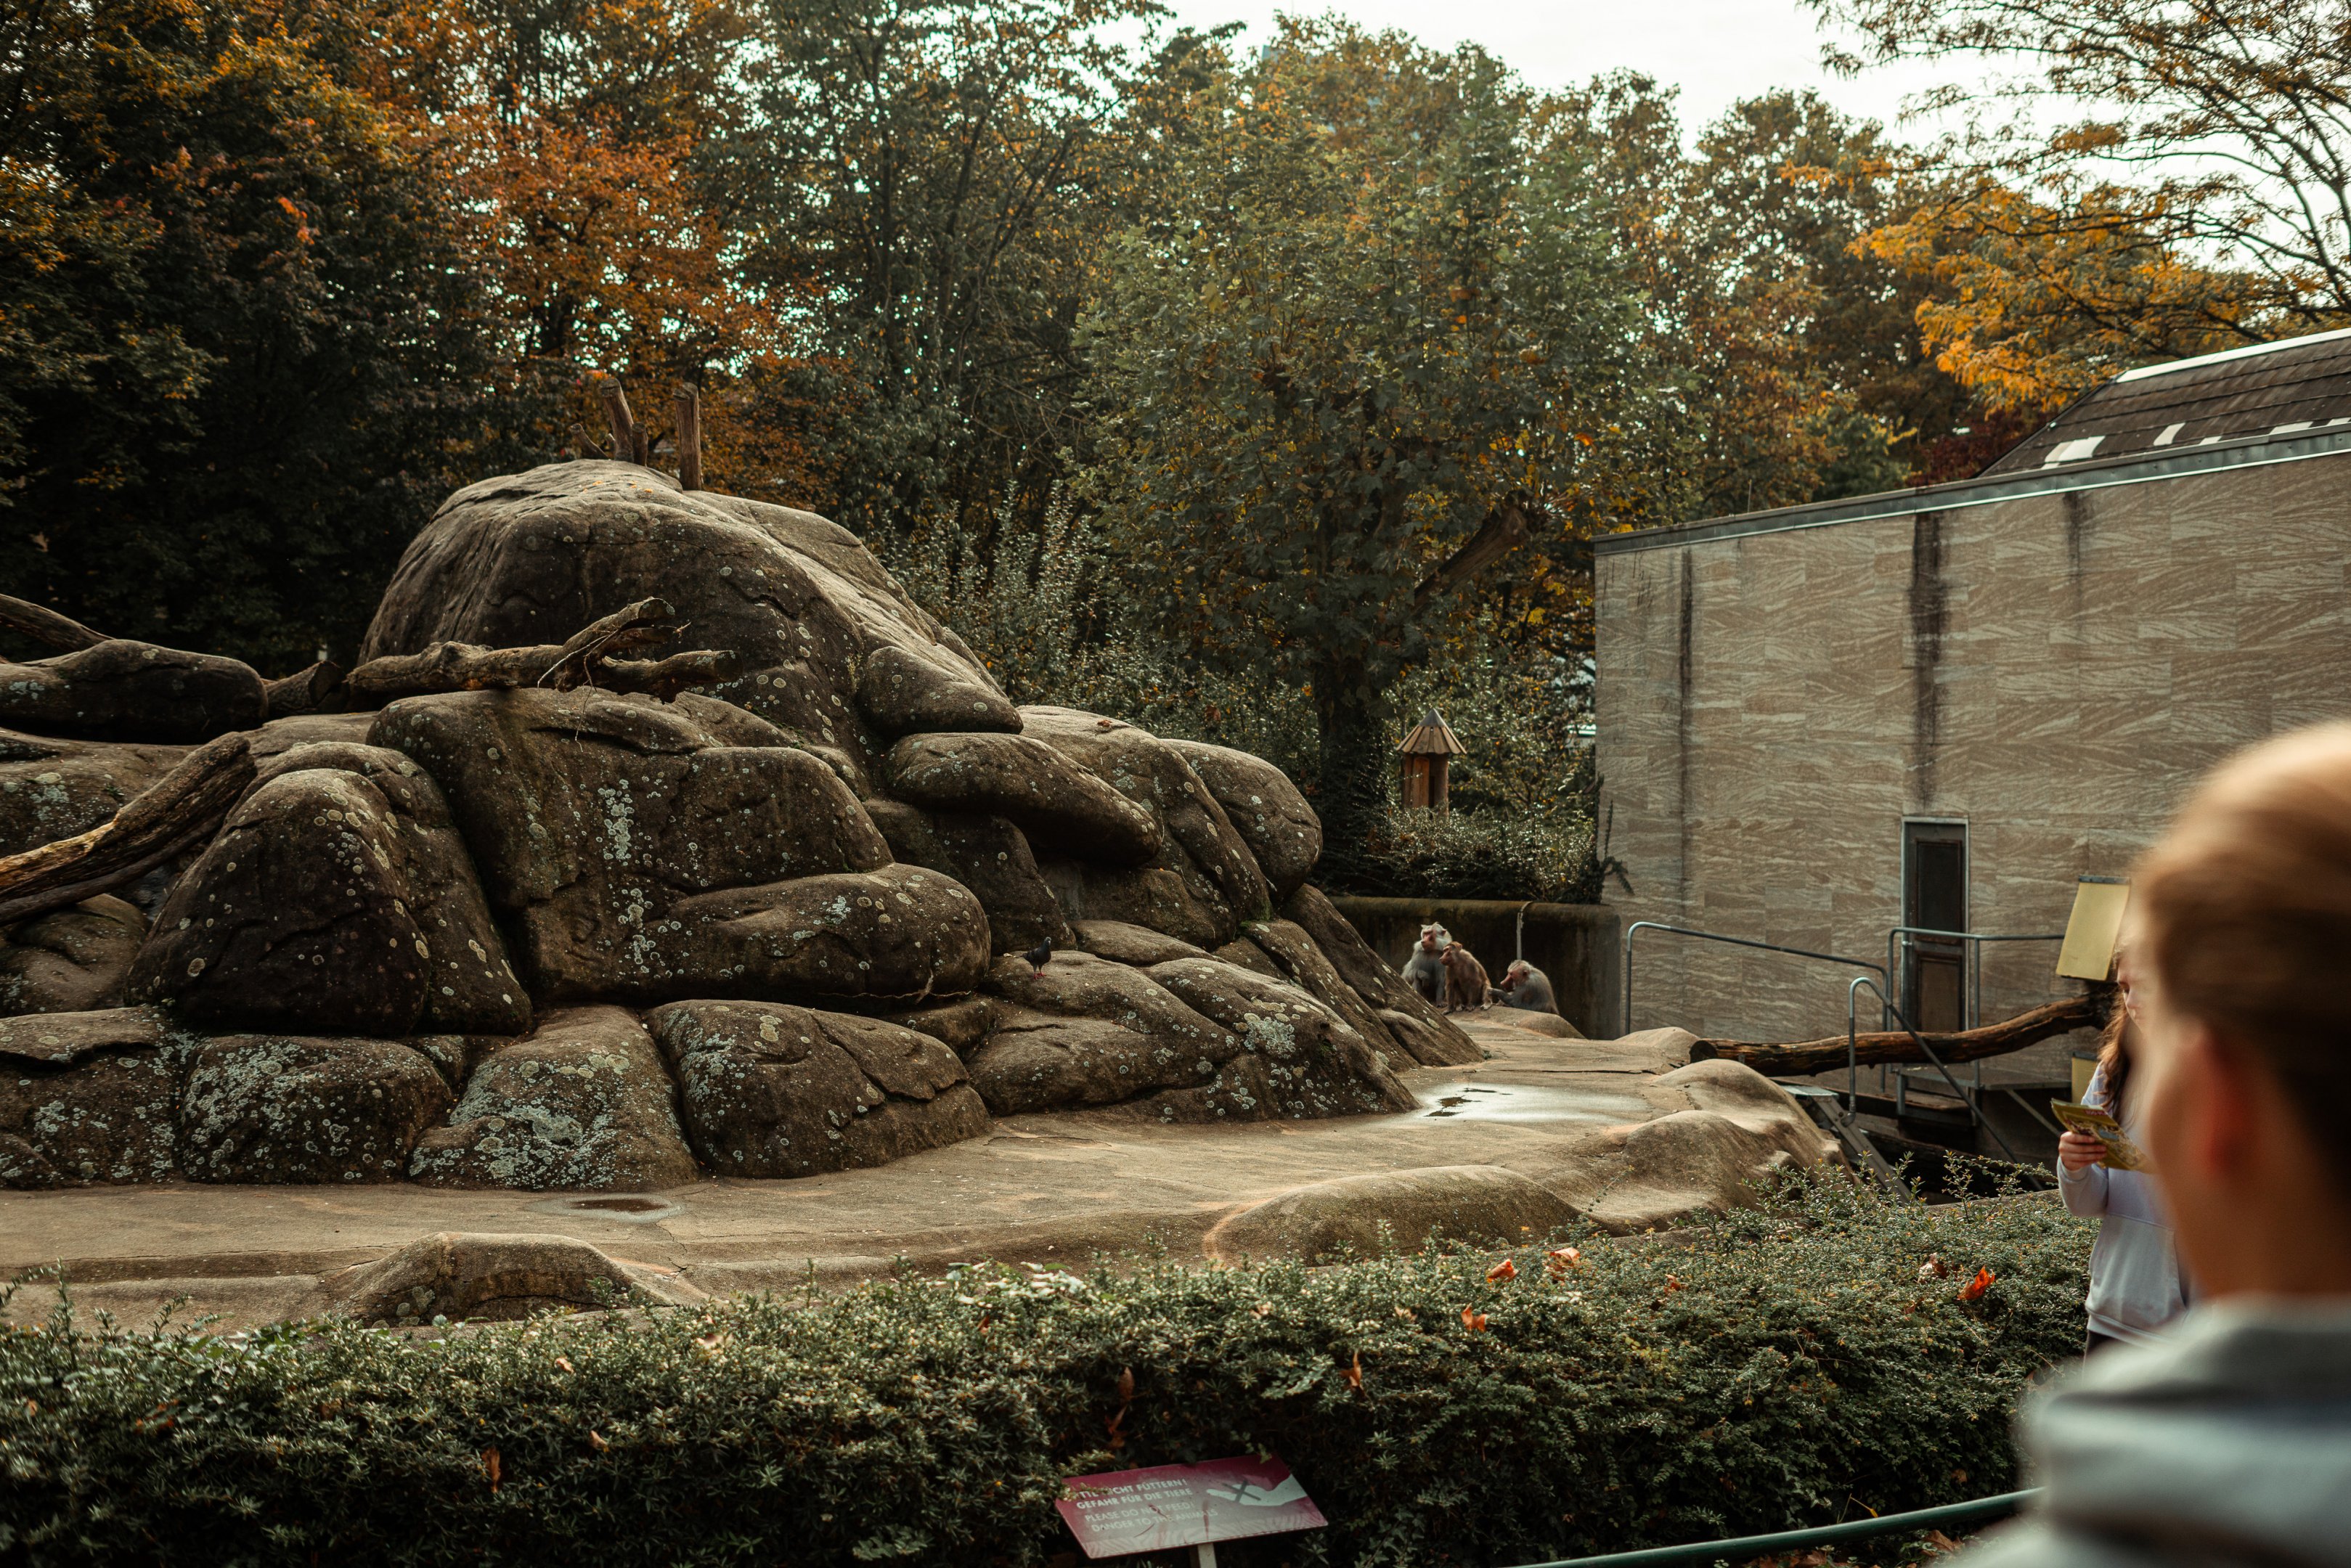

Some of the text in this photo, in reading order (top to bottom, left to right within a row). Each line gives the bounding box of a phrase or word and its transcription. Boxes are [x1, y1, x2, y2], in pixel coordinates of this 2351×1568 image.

[1136, 1478, 1188, 1491] FÜTTERN!
[1077, 1488, 1193, 1508] GEFAHR FÜR DIE TIERE
[1085, 1511, 1120, 1522] PLEASE
[1121, 1508, 1138, 1517] DO
[1091, 1520, 1135, 1532] DANGER
